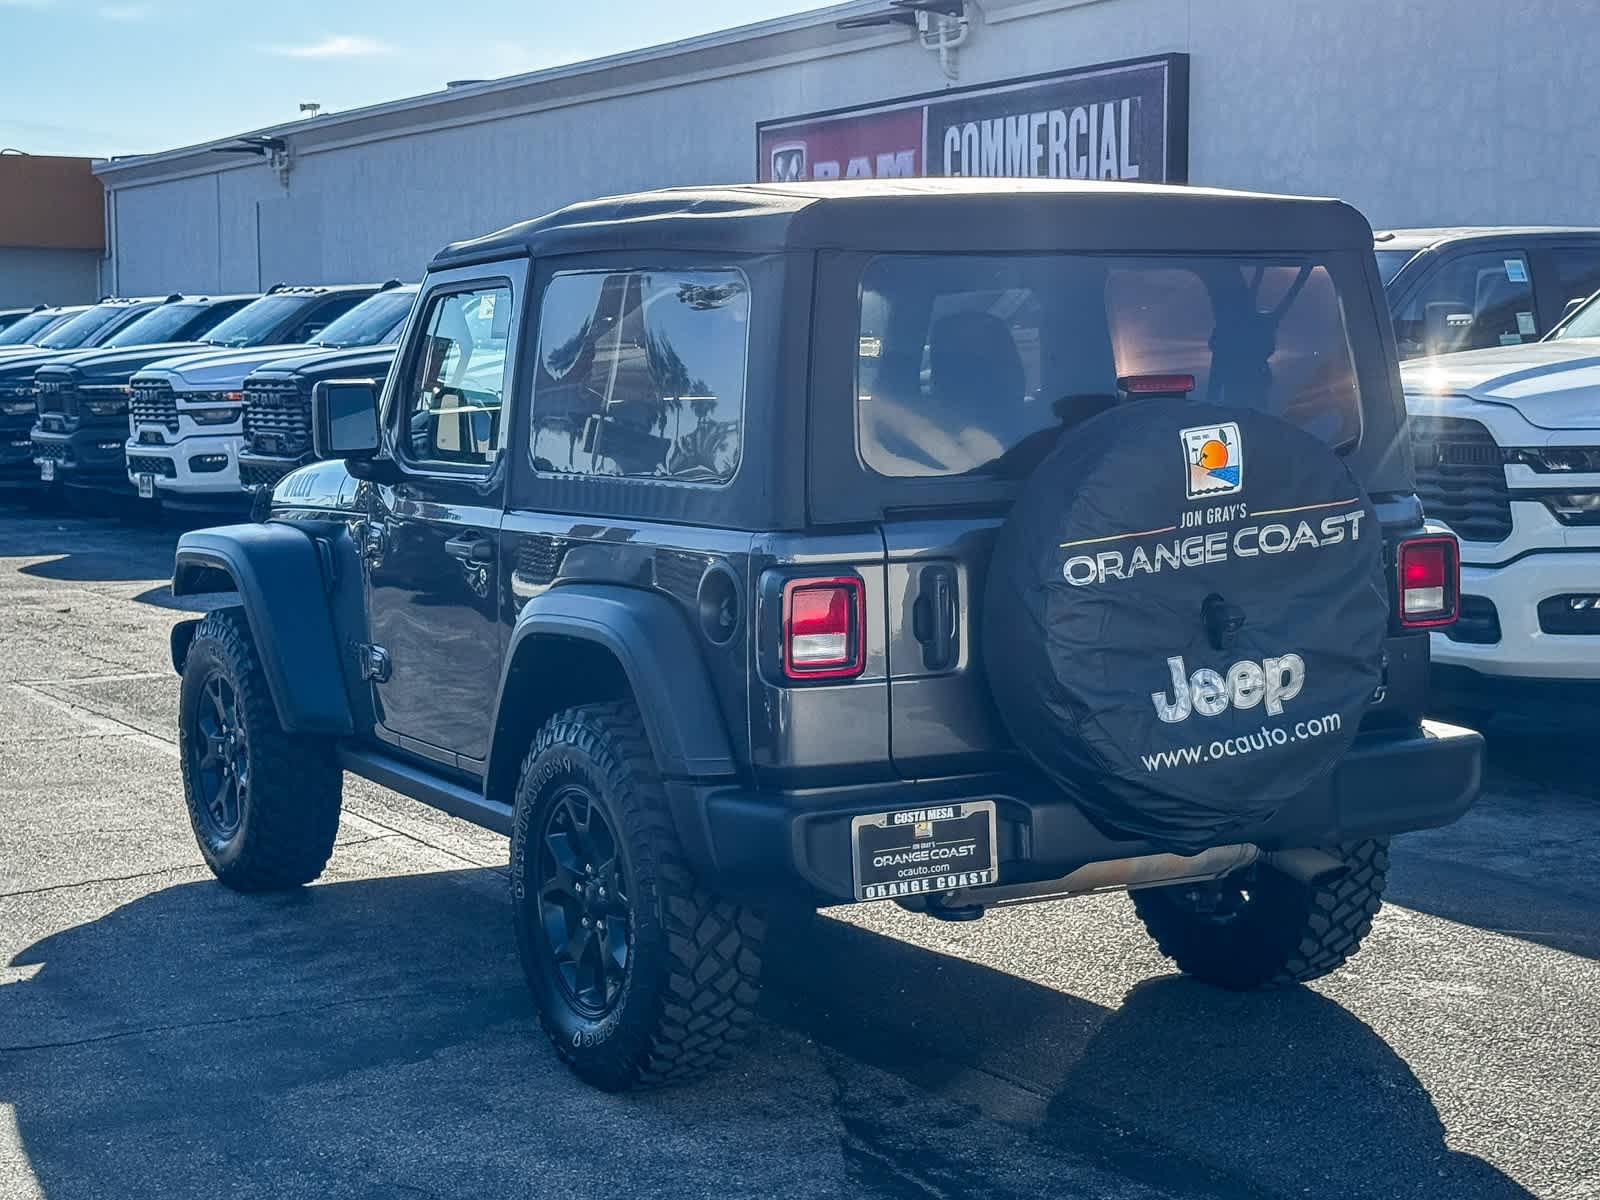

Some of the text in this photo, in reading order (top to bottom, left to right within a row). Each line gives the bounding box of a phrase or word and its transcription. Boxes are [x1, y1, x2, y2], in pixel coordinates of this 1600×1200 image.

[943, 98, 1140, 178] COMMERCIAL
[1180, 502, 1247, 529] JON GRAY'S
[1063, 510, 1365, 586] ORANGE COAST
[1151, 653, 1306, 723] Jeep
[1141, 712, 1342, 772] www.ocauto.com
[894, 807, 954, 824] COSTA MESA
[873, 850, 929, 868] ORANGE
[930, 845, 976, 860] COAST
[897, 863, 950, 878] ocauto.com
[866, 871, 988, 898] ORANGE COAST
